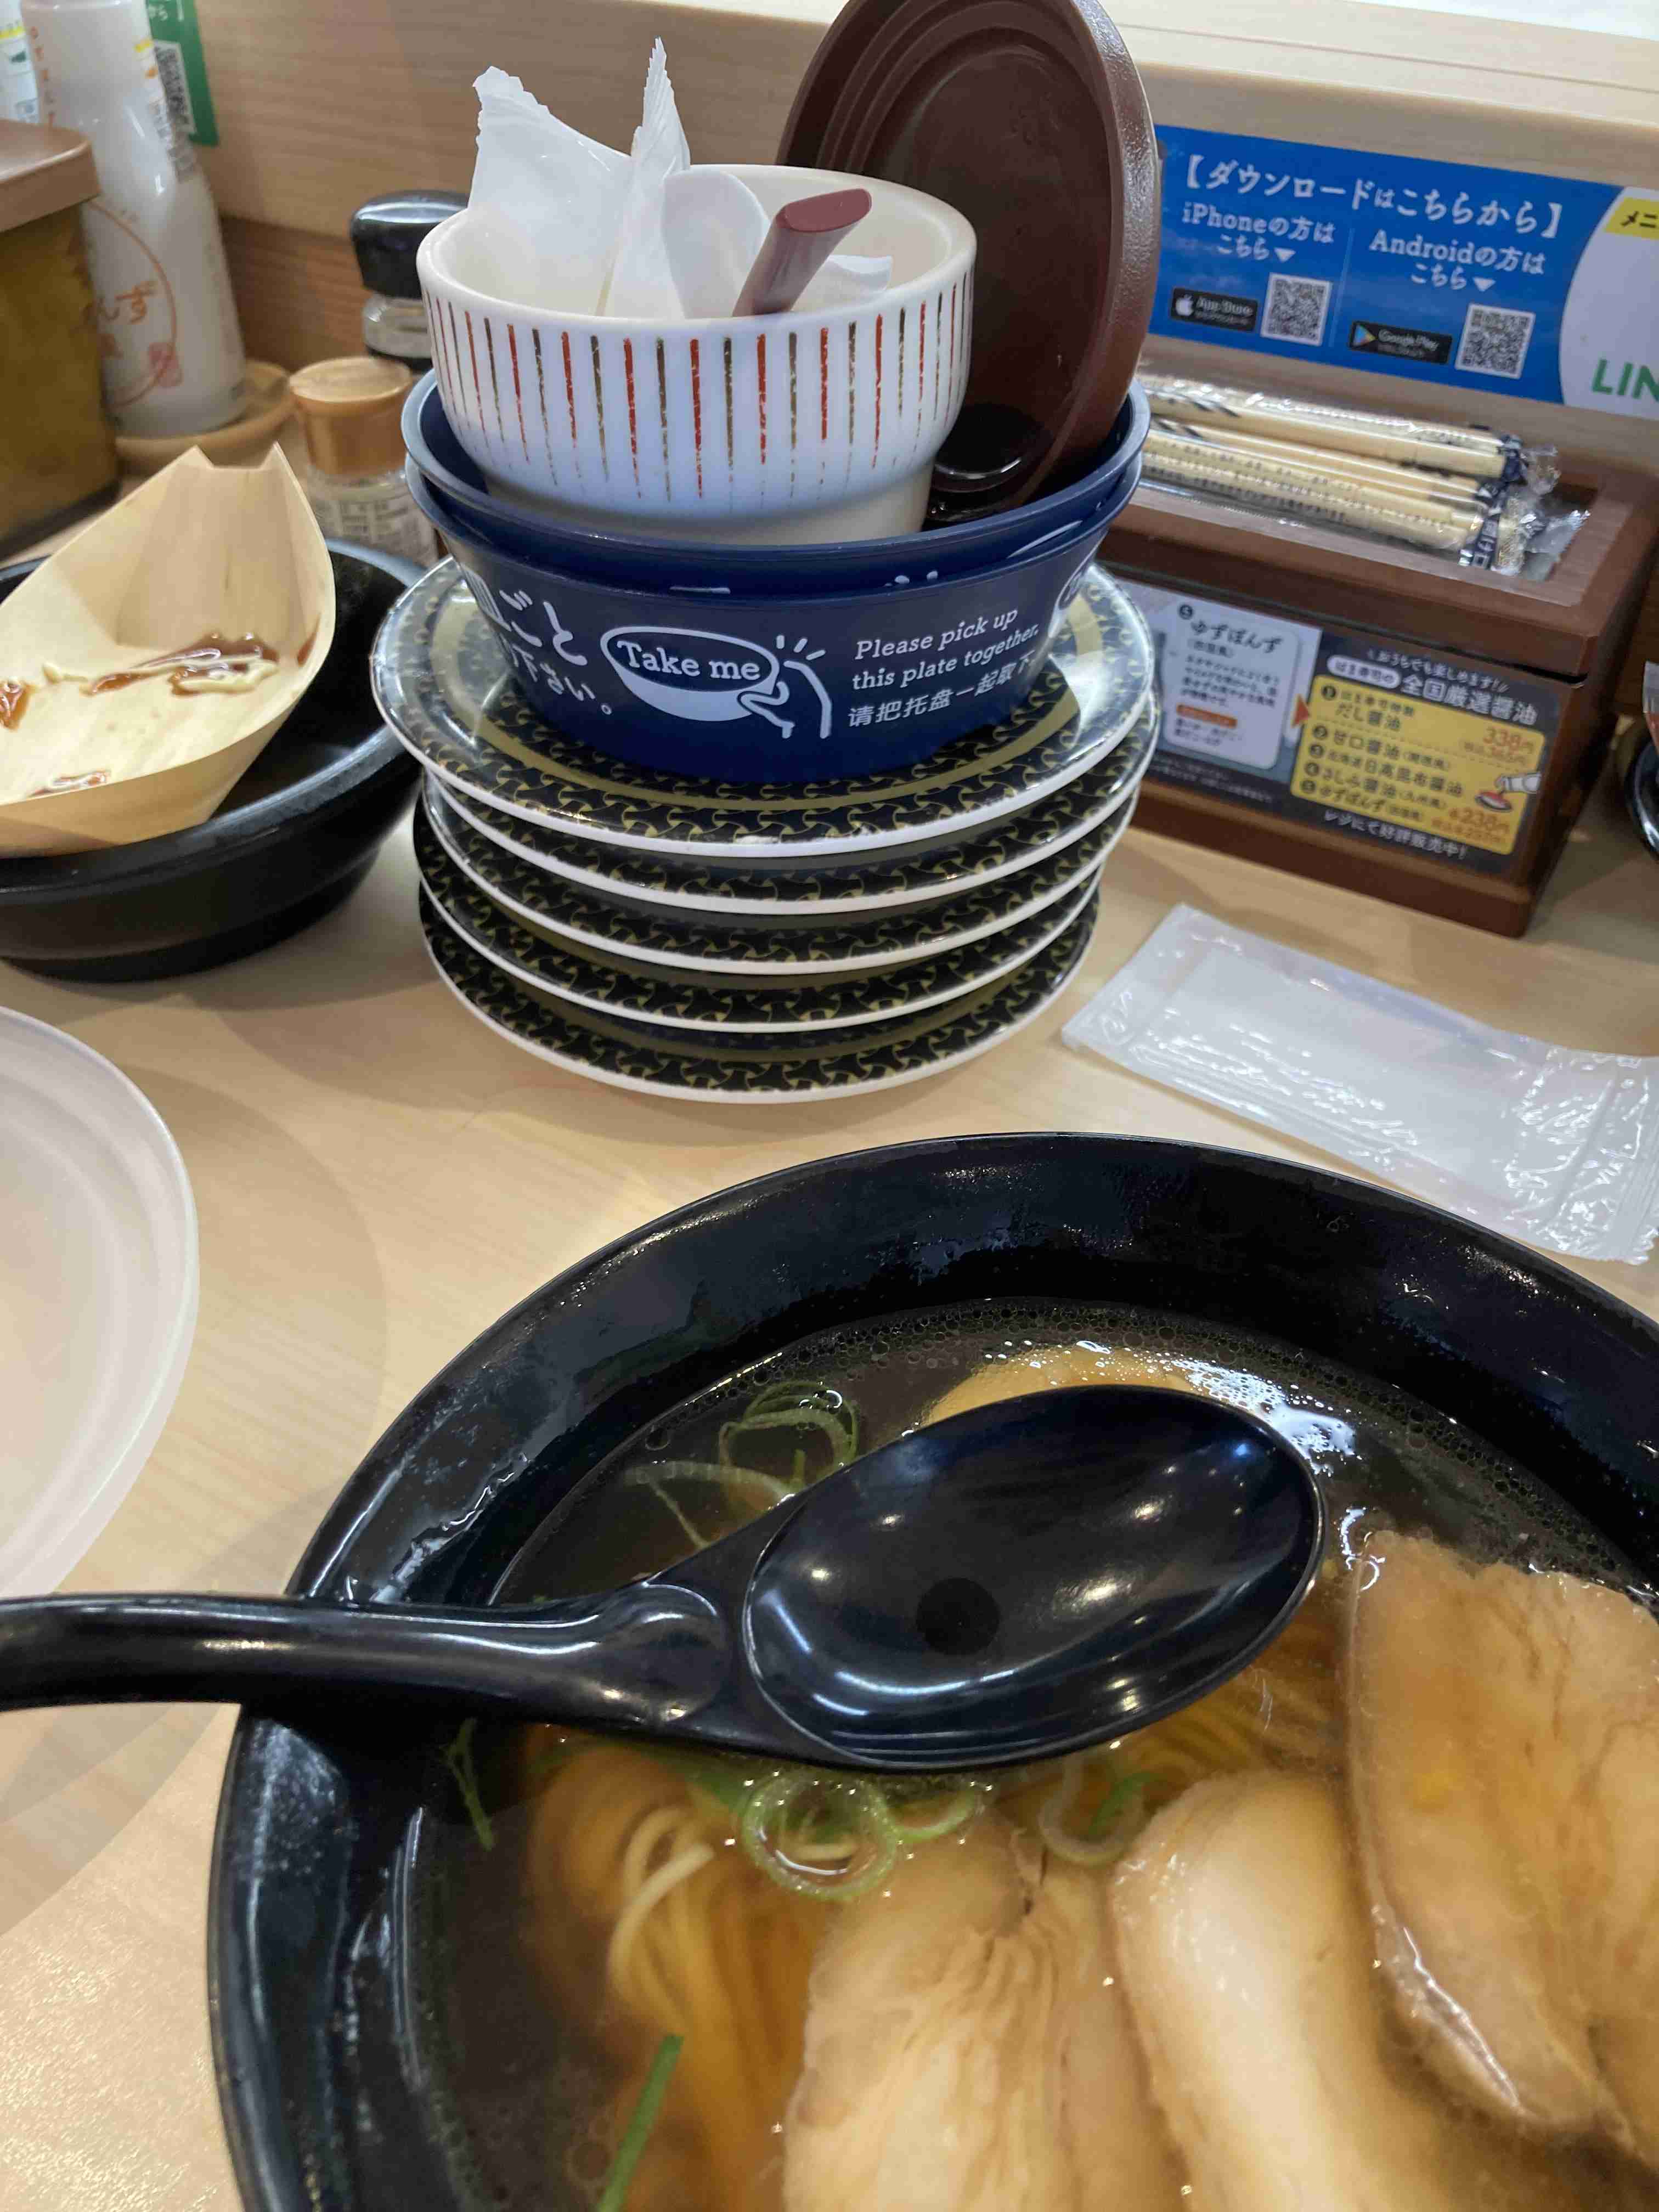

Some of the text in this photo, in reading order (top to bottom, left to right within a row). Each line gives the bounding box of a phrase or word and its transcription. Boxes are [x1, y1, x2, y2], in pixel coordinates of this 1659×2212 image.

[1187, 154, 1562, 238] 【ダウンロードはこちらから】
[1182, 201, 1335, 243] iPhoneの方は
[1369, 229, 1545, 274] Androidの方は
[852, 624, 1039, 690] this plate together.
[855, 608, 1018, 660] Please pick up
[617, 640, 760, 680] Take me
